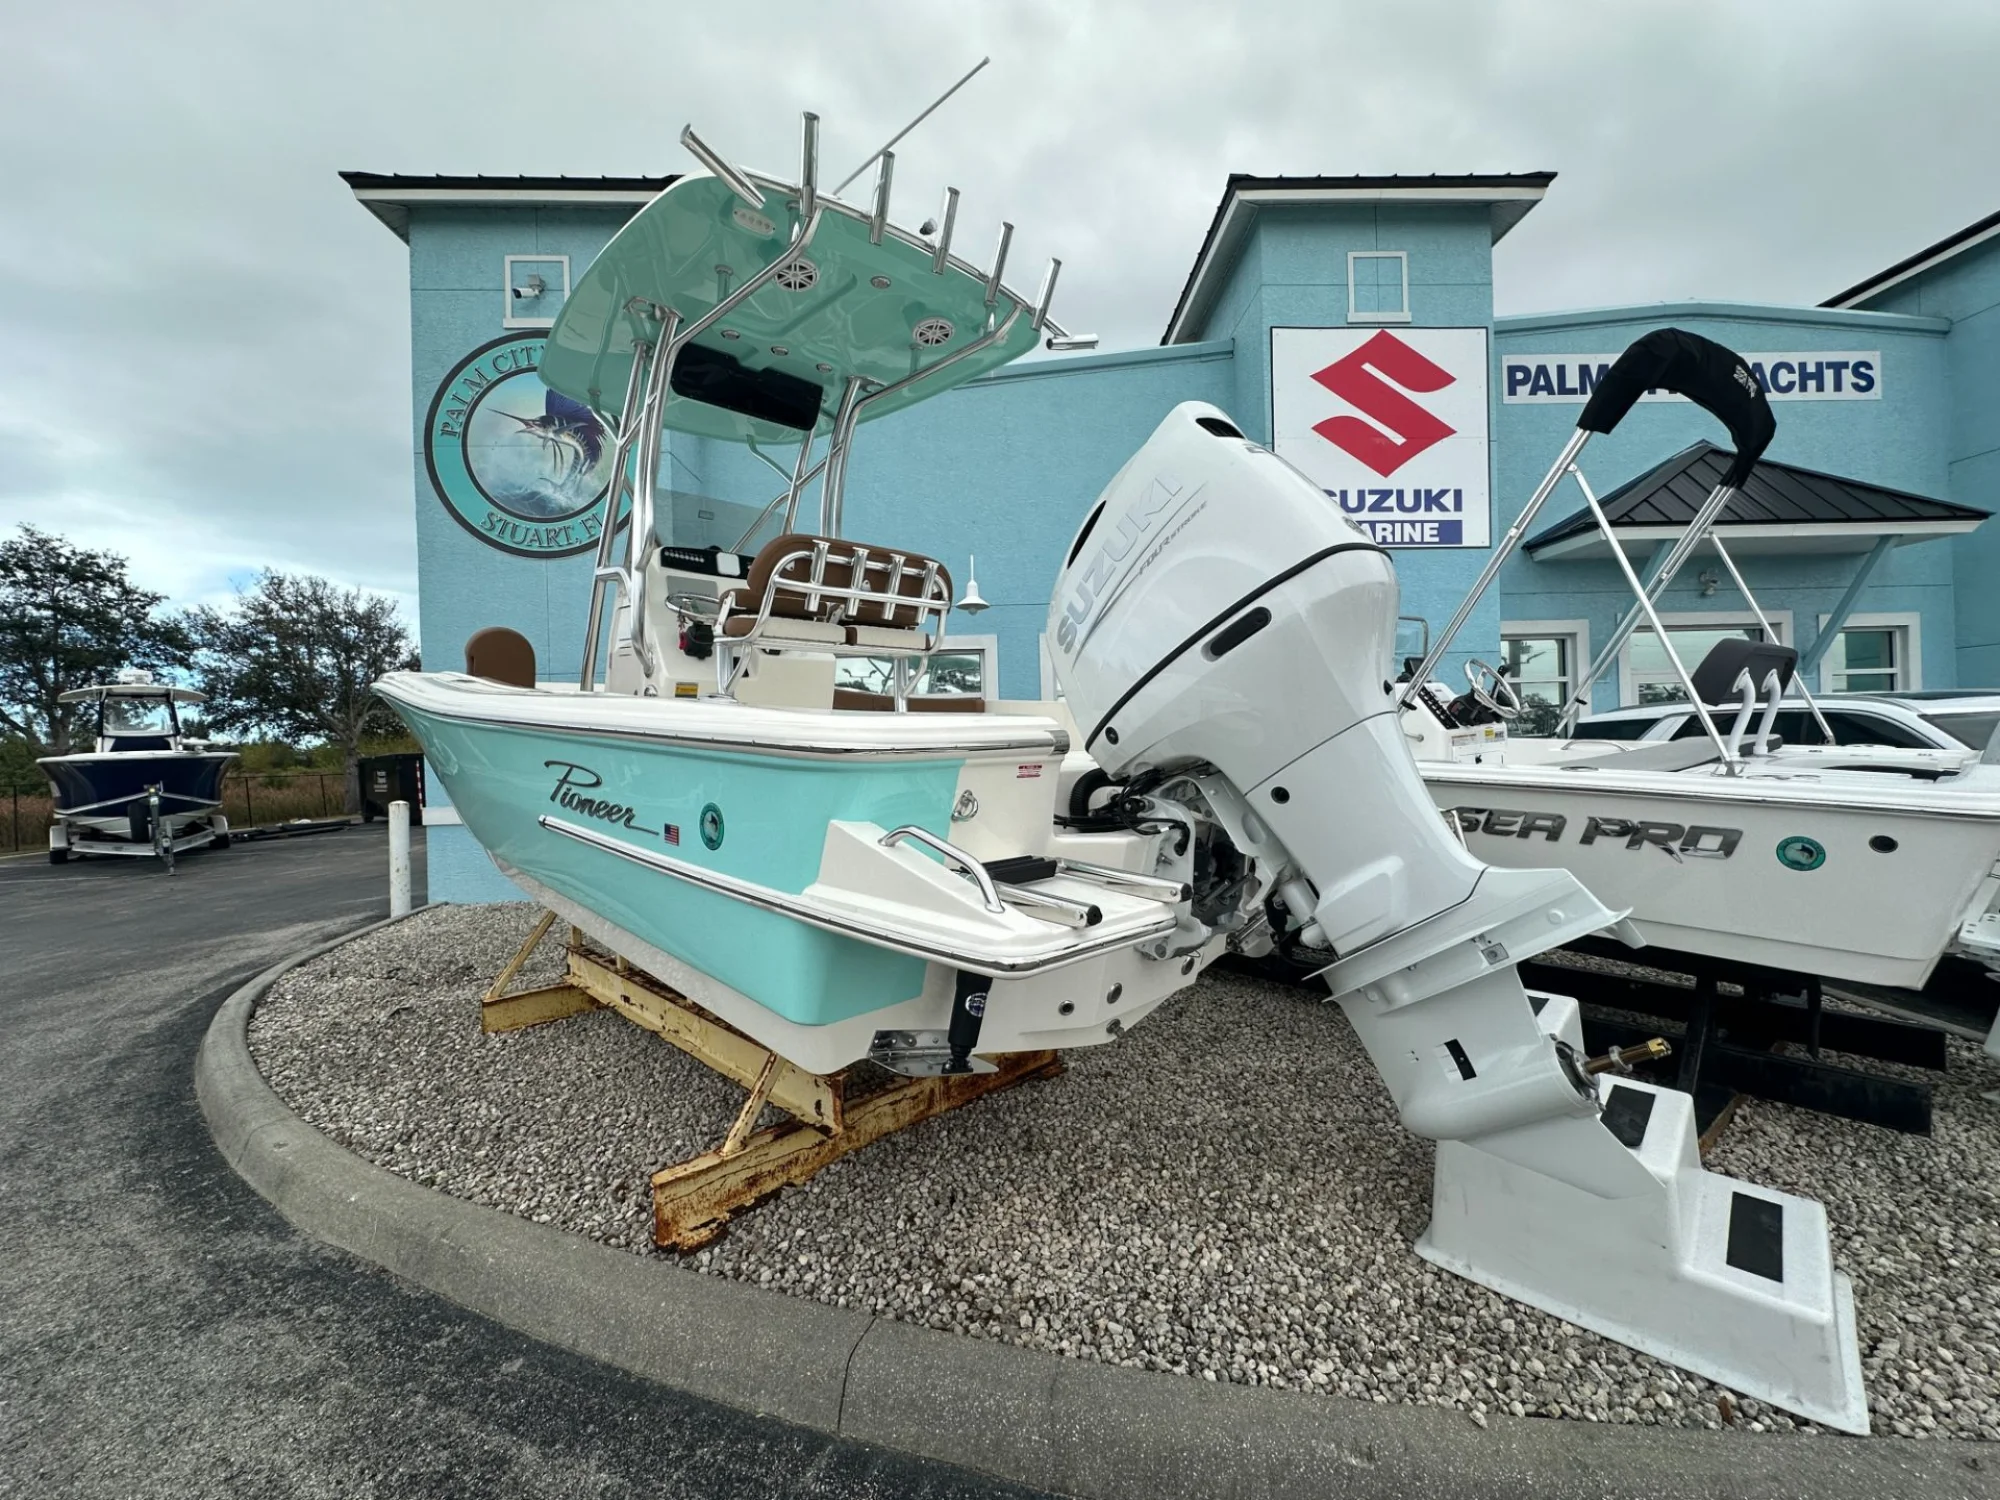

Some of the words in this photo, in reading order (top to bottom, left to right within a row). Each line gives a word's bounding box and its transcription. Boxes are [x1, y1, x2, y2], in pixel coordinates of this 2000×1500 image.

[440, 367, 492, 440] PALM
[492, 345, 545, 374] CIT
[1750, 360, 1875, 394] ACHTS
[480, 511, 582, 548] STUART,
[1322, 488, 1463, 514] UZUKI
[1057, 470, 1184, 654] SUZUKI
[544, 759, 660, 836] Pioneer
[1456, 806, 1567, 842] SEA
[1578, 815, 1744, 864] PRO
